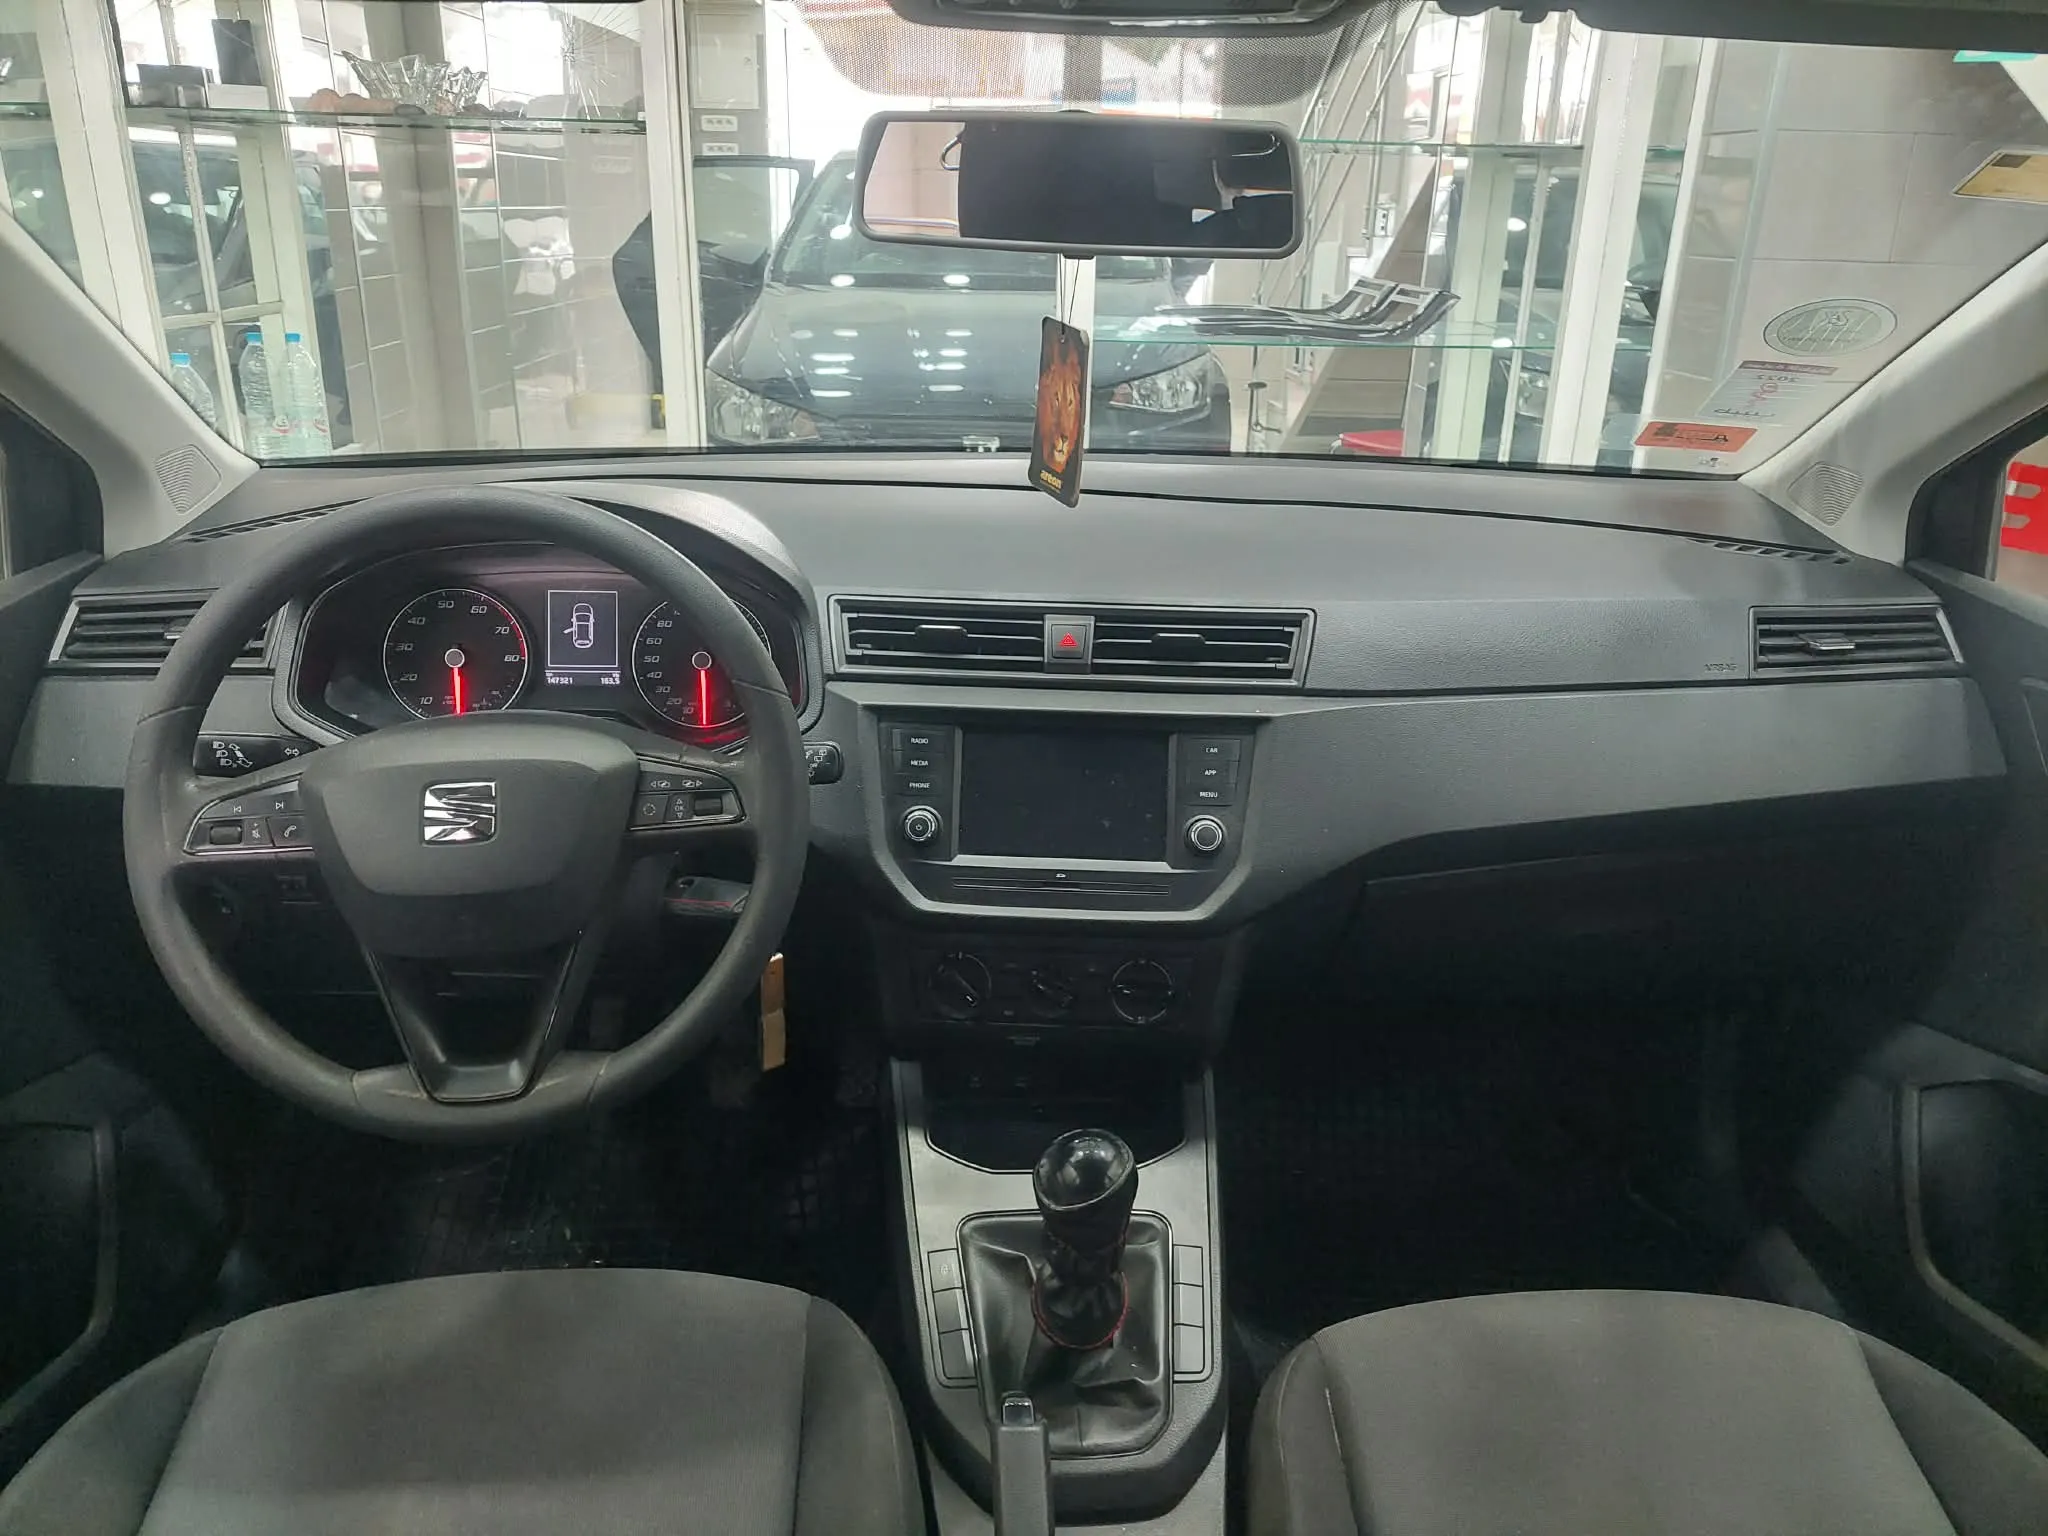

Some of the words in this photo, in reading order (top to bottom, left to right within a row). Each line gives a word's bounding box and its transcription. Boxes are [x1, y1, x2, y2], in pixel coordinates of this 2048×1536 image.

[437, 600, 455, 609] 50
[470, 605, 488, 614] 60
[408, 617, 426, 625] 40
[656, 620, 673, 628] 80
[495, 626, 510, 634] 70
[646, 637, 663, 645] 60
[395, 643, 413, 651] 30
[504, 654, 520, 662] 80
[643, 655, 660, 663] 50
[400, 673, 418, 681] 20
[646, 671, 663, 679] 40
[655, 685, 671, 693] 30
[419, 696, 433, 705] 10
[666, 697, 682, 705] 20
[682, 706, 694, 714] 10
